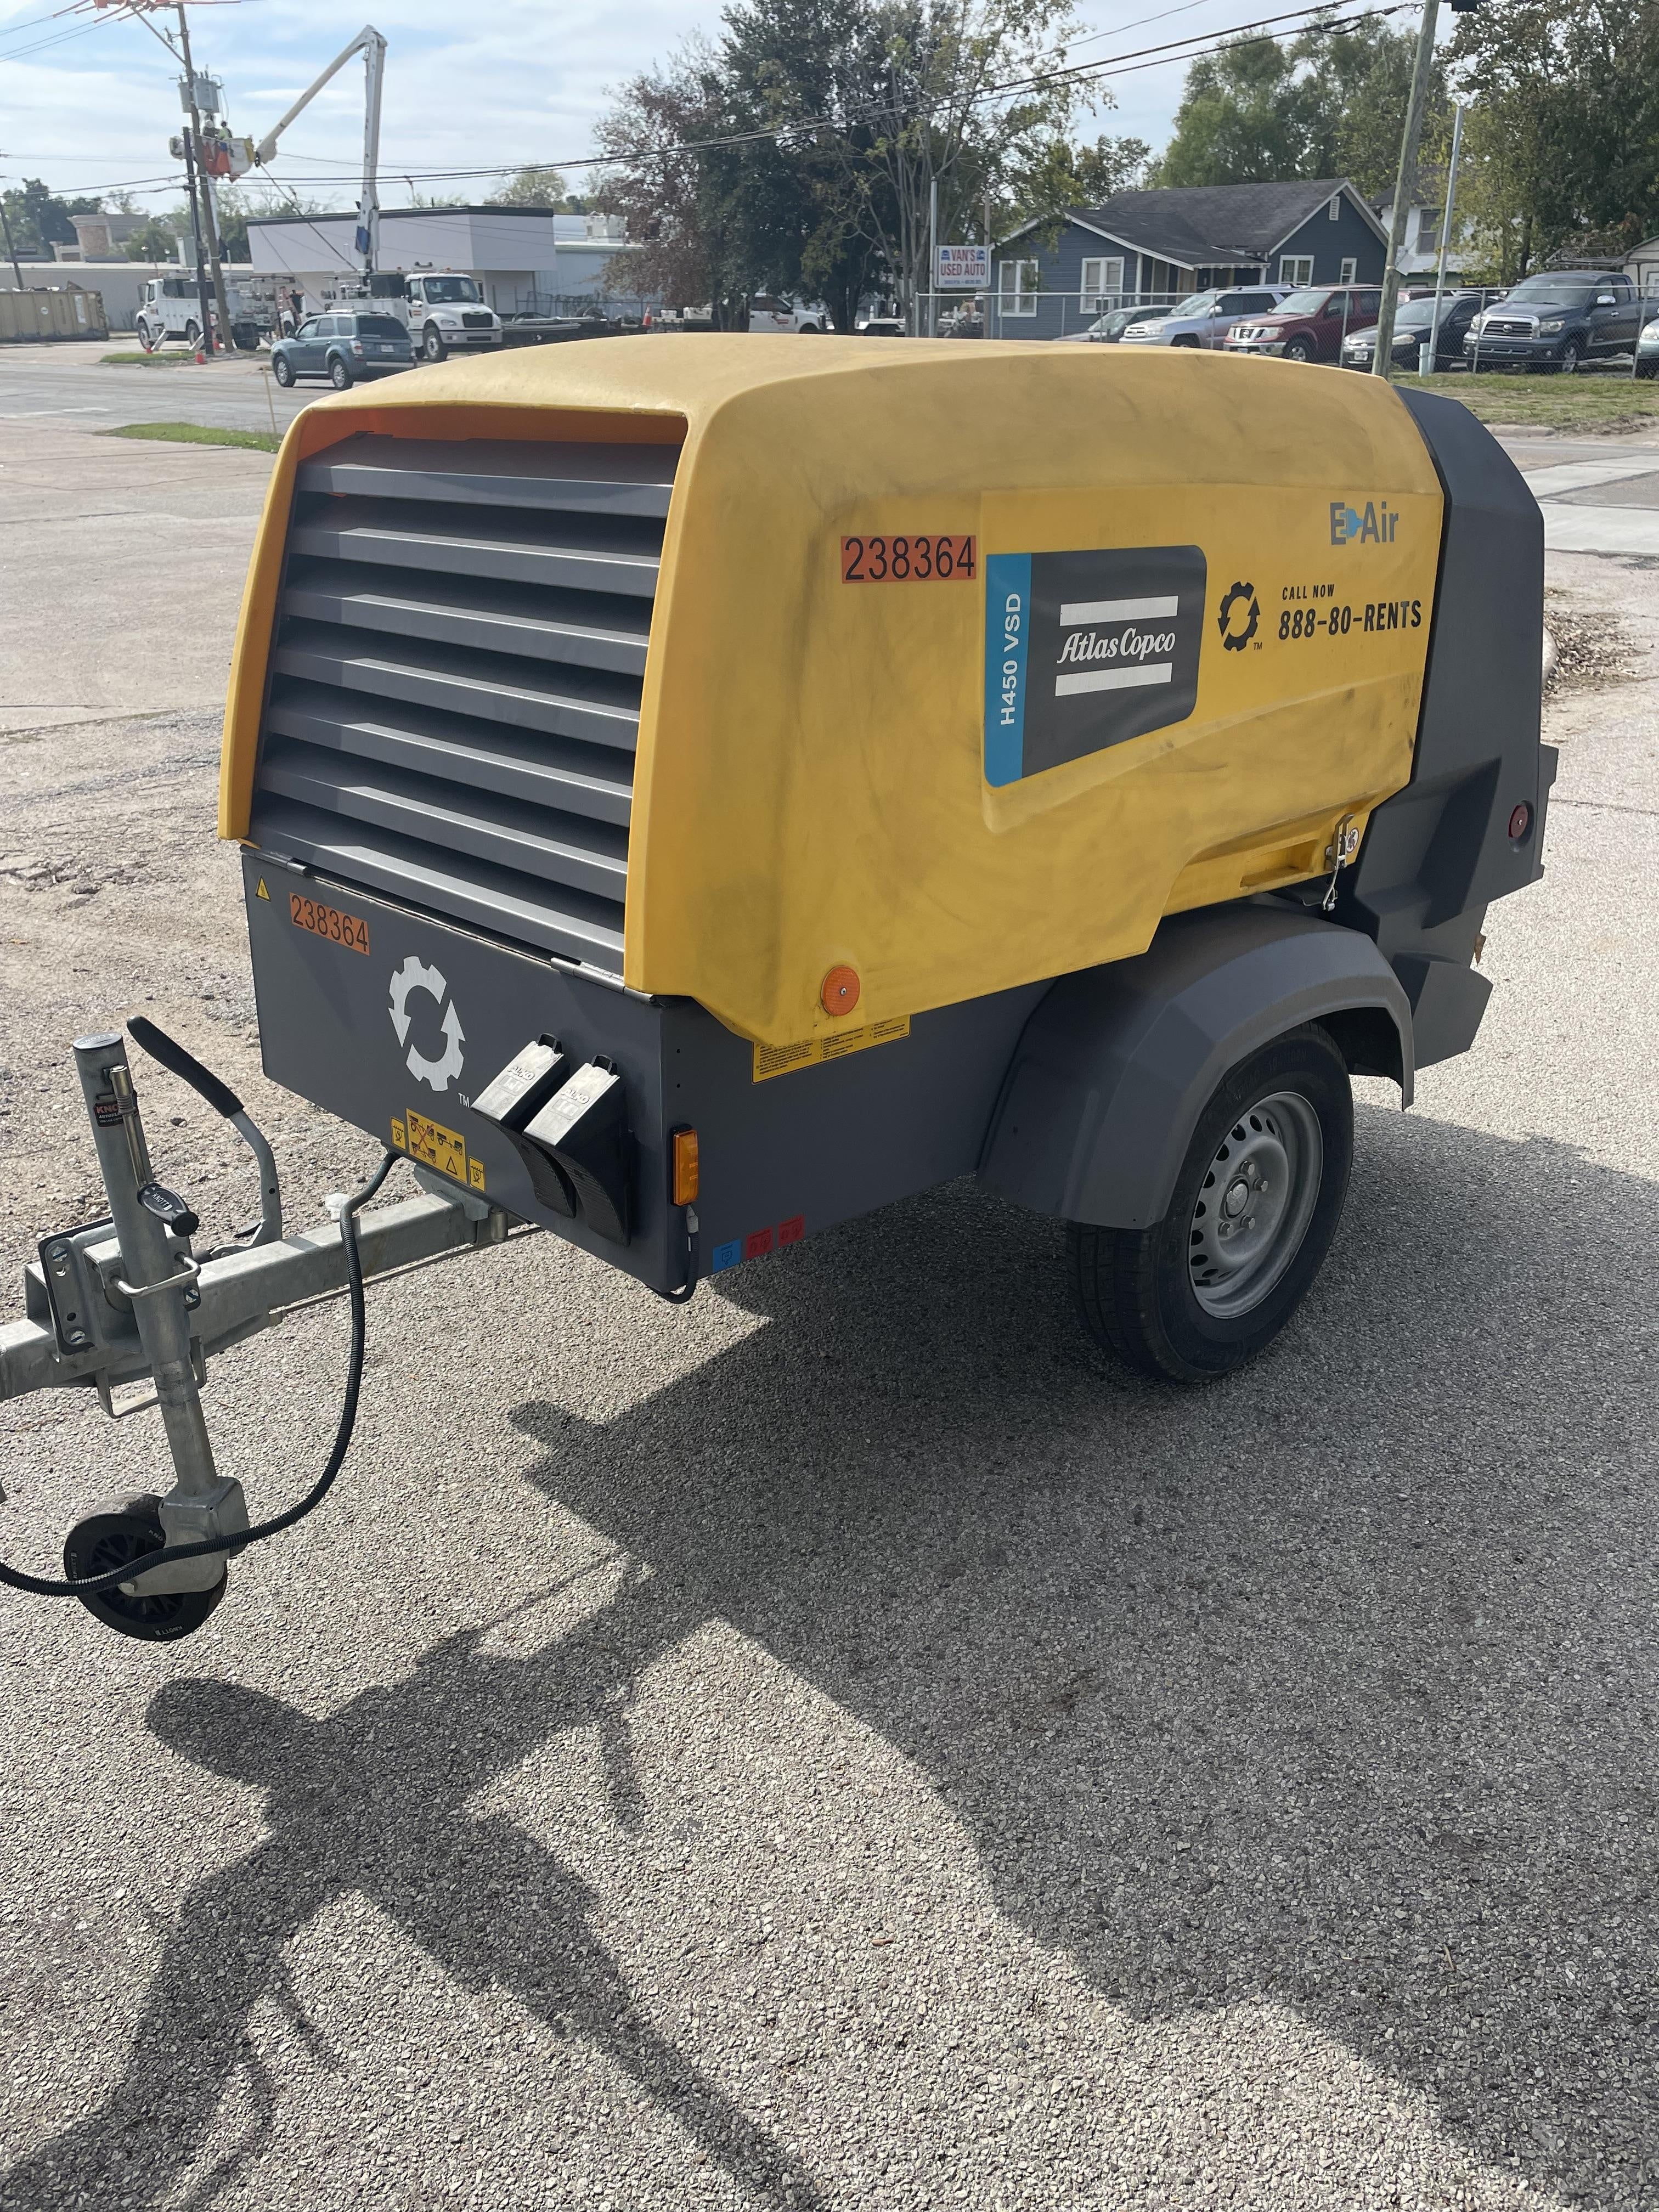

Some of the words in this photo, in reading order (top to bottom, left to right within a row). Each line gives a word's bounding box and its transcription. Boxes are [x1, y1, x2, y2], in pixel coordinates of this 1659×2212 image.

[951, 250, 975, 261] VAN'S
[940, 264, 962, 275] USED
[964, 263, 986, 275] AUTO
[845, 537, 974, 580] 238364
[1282, 585, 1307, 600] CALL
[1312, 584, 1335, 599] NOW
[1003, 593, 1020, 652] VSD
[1278, 600, 1422, 640] 888-80-RENTS
[1253, 642, 1263, 651] TM
[1000, 660, 1018, 725] H450
[291, 894, 369, 952] 238364
[458, 1092, 471, 1108] TM
[96, 1104, 119, 1114] KNO
[151, 1193, 170, 1206] KNOTT
[161, 1625, 183, 1635] KNOTT
